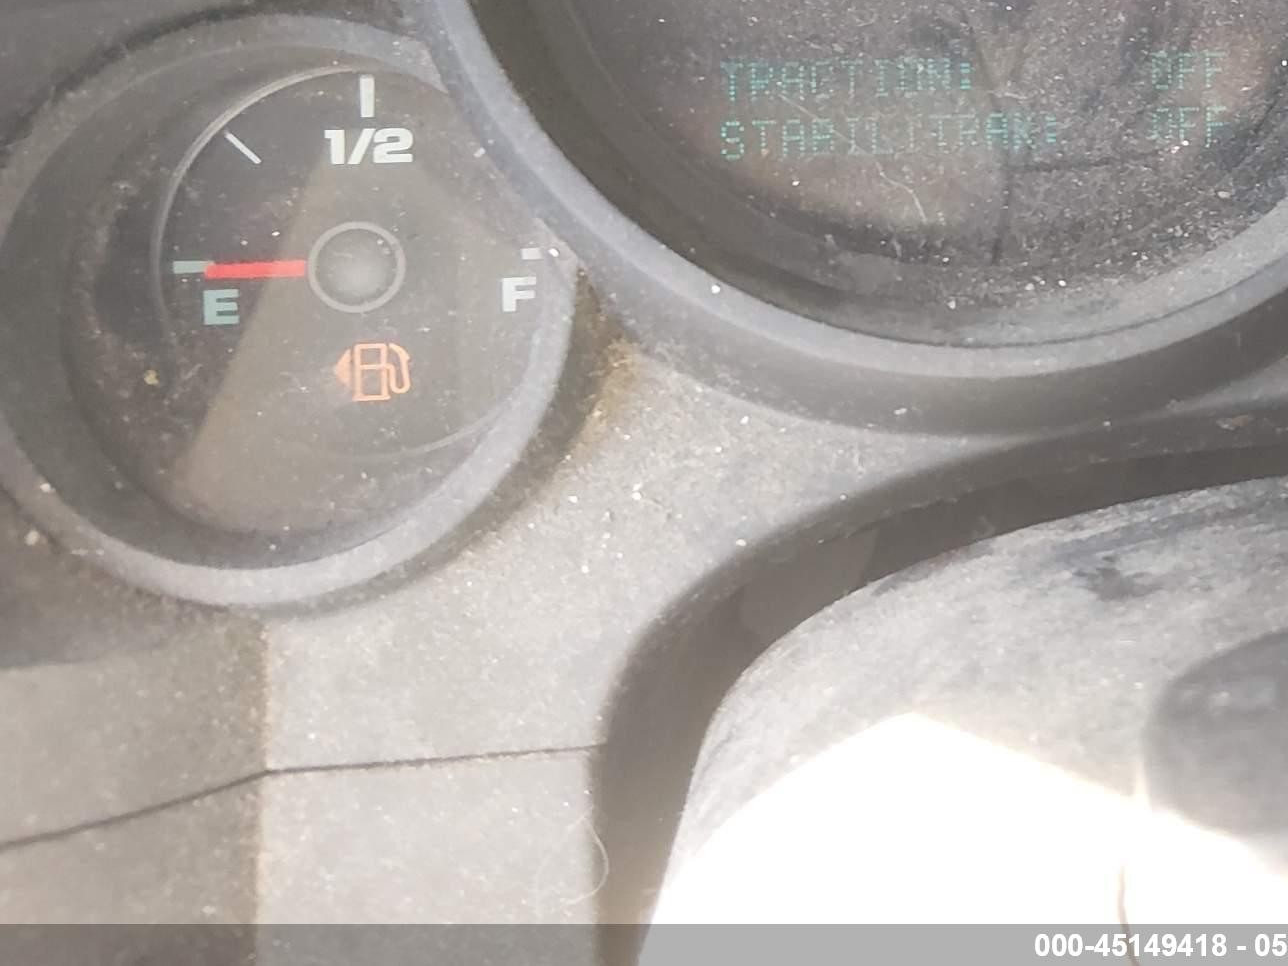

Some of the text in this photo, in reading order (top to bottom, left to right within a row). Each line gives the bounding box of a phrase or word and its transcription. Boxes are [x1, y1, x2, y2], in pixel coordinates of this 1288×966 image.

[1150, 51, 1227, 89] OFF
[324, 127, 414, 165] 1/2
[203, 289, 240, 325] E
[501, 276, 537, 312] F
